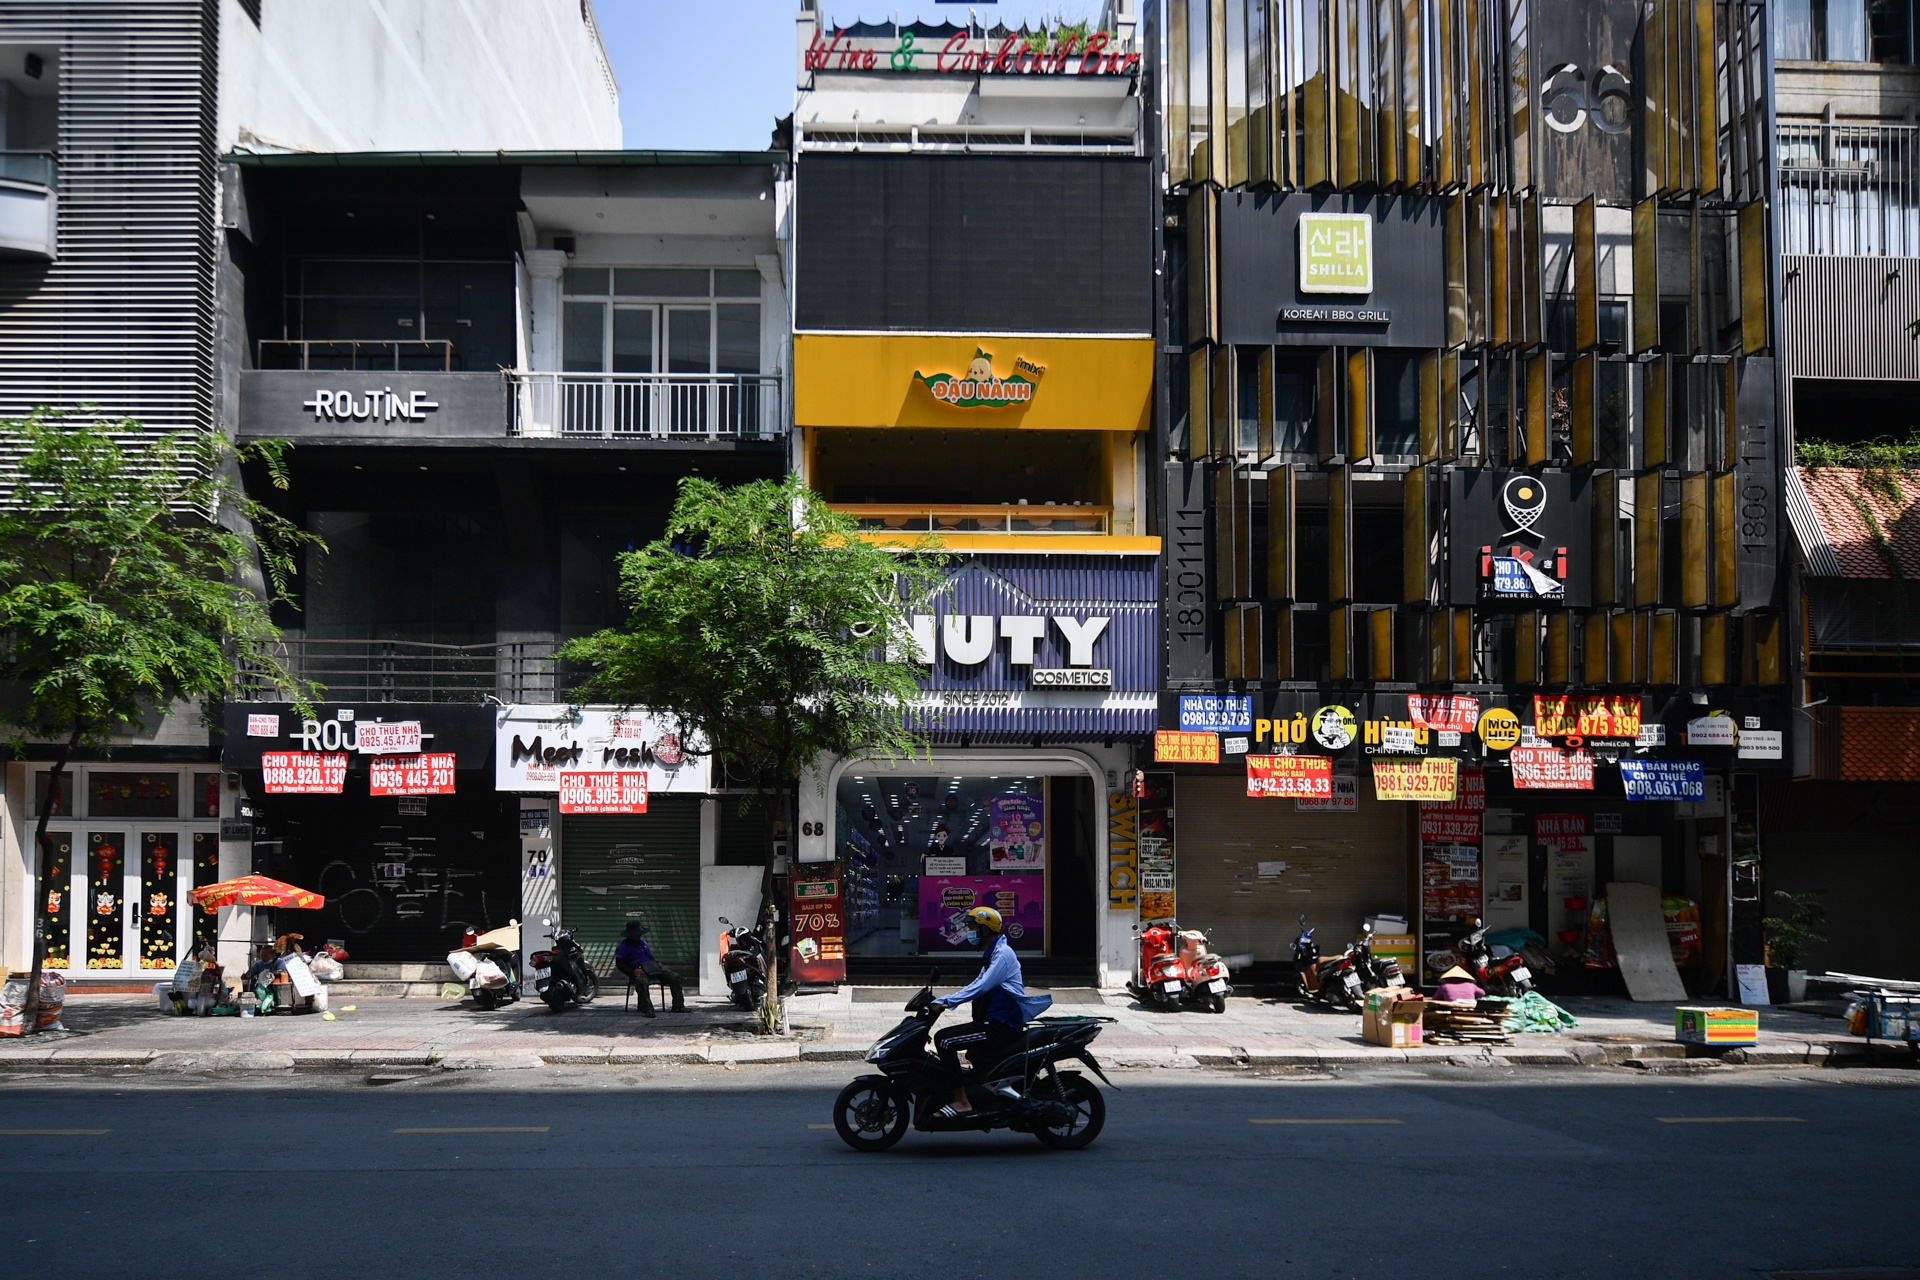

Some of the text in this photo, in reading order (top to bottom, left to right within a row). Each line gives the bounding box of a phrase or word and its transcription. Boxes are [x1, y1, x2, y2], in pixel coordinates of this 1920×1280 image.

[805, 28, 1141, 73] Wine & Cocktail Bar
[1310, 226, 1364, 259] 신라
[1309, 264, 1364, 276] SHILLA
[1284, 309, 1389, 321] KOREAN BBQ GRILL
[932, 378, 1031, 402] ĐẬU NÀNH
[1176, 511, 1204, 642] 18001111
[886, 615, 1111, 666] NUTY
[1034, 671, 1109, 685] COSMETICS
[943, 693, 1009, 707] SINCE 2012
[1184, 696, 1247, 711] NHÀ CHO THUÊ
[1409, 697, 1478, 710] CHO THUÊ NHÀ
[1536, 698, 1638, 717] CHO THUÊ NHÀ
[1182, 712, 1250, 726] 0981.929.705
[1411, 708, 1479, 723] 0911 7777 69
[360, 724, 419, 736] CHO THUÊ NHÀ
[1256, 711, 1307, 743] PHỞ
[1537, 715, 1639, 737] 0908 875 399
[360, 735, 419, 747] 0925.45.47.47
[511, 734, 583, 764] Meet
[586, 736, 656, 764] Fresh
[264, 752, 347, 768] CHO THUÊ NHÀ
[1158, 745, 1217, 760] 0922.16.36.36
[1510, 750, 1534, 763] CHO
[1537, 748, 1565, 764] THUÊ
[1568, 750, 1593, 764] NHÀ
[371, 754, 454, 771] CHO THUÊ NHÀ
[1248, 756, 1328, 769] NHÀ CHO THUÊ
[1373, 757, 1455, 774] NHÀ CHO THUÊ
[1620, 760, 1700, 773] NHÀ BÁN HOẶC
[264, 768, 347, 785] 0888.920.130
[372, 769, 454, 788] 0936 445 201
[561, 774, 587, 788] CHO
[589, 772, 619, 788] THUÊ
[622, 772, 646, 788] NHÀ
[1466, 774, 1485, 792] NHÀ
[1633, 770, 1687, 781] CHO THUÊ
[1248, 778, 1329, 792] 0942.33.58.33
[1336, 780, 1355, 793] NHÀ
[1625, 780, 1703, 796] 0908.061.068
[561, 788, 646, 805] 0906.905.006
[1332, 798, 1341, 806] 97
[1343, 798, 1355, 806] 86
[255, 826, 267, 835] 72
[802, 821, 824, 837] 68
[1422, 821, 1479, 836] 0931.339.227
[1537, 816, 1560, 834] NHÀ
[1563, 816, 1585, 834] BÁN
[527, 850, 547, 863] 70
[1109, 793, 1137, 910] SWITCH
[795, 913, 840, 932] 70%
